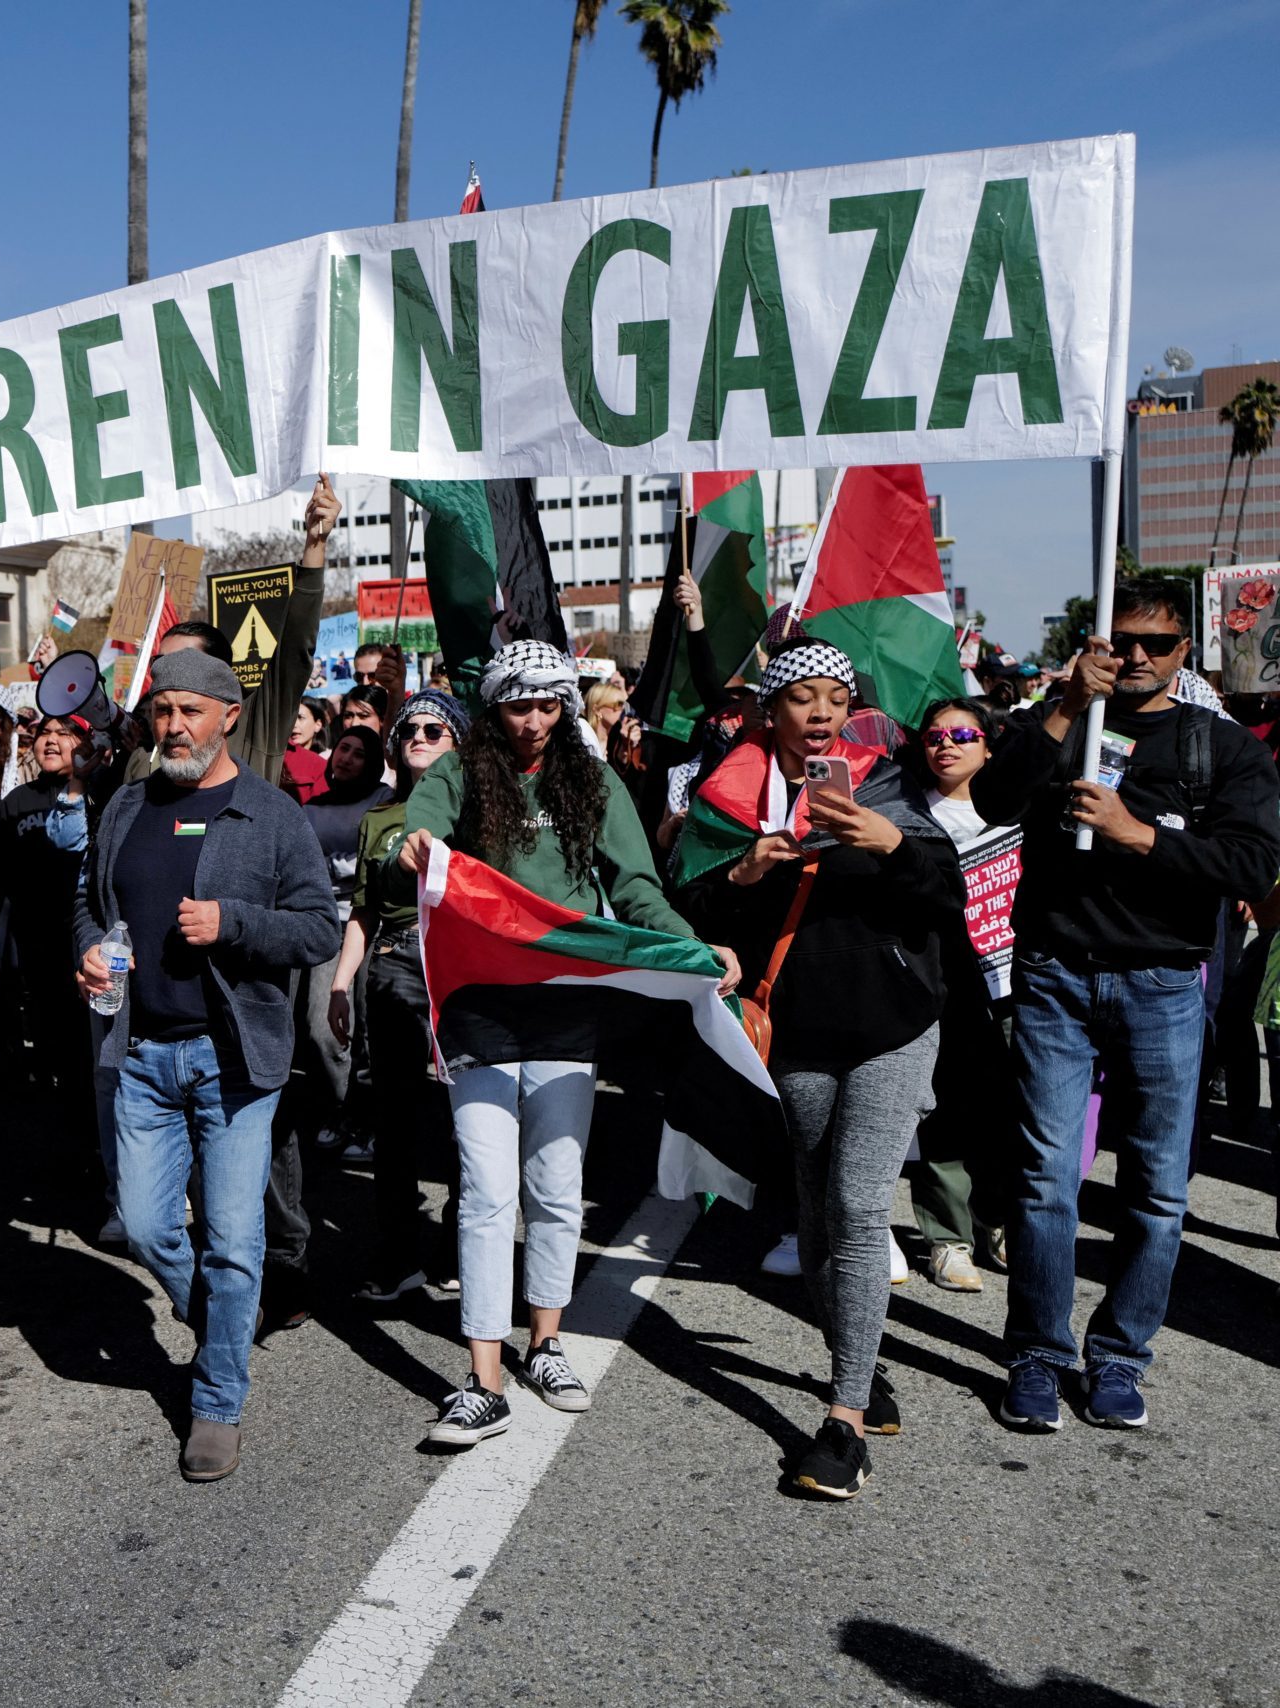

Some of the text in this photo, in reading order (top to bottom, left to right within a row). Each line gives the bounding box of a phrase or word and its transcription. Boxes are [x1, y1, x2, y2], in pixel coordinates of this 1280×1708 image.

[327, 240, 483, 453] IN
[562, 177, 1064, 448] GAZA
[216, 576, 289, 595] WHILE YOU'RE
[224, 588, 282, 604] WATCHING
[981, 852, 1018, 879] לעצור
[964, 903, 983, 921] TOP
[984, 892, 1009, 913] THE
